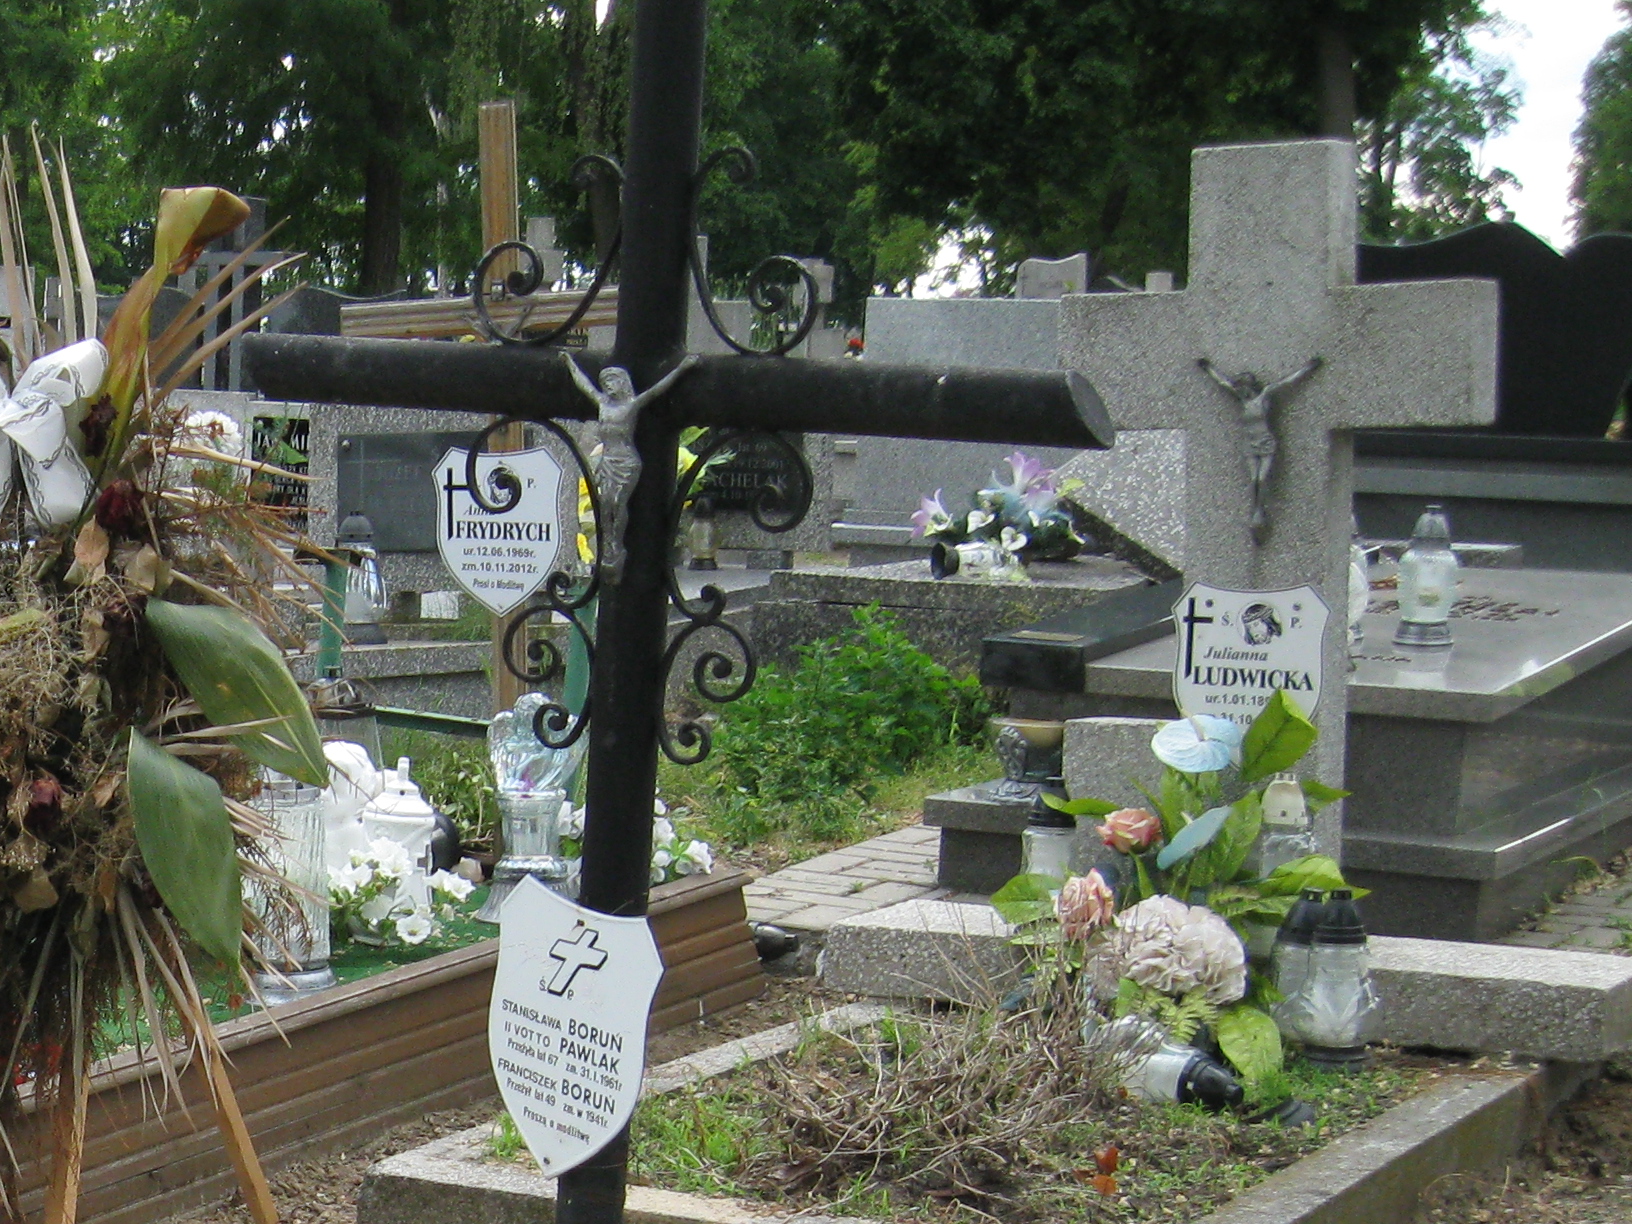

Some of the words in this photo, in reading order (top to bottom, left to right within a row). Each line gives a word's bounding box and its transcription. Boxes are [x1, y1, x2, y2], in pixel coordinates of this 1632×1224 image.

[527, 478, 538, 489] P.
[455, 519, 551, 541] FRYDRYCH
[1203, 646, 1268, 661] Julianna
[1192, 665, 1314, 691] LUDWICKA
[502, 998, 562, 1032] STANISŁAWA
[568, 1018, 624, 1053] BORUŃ
[547, 1053, 559, 1067] 67
[559, 1037, 621, 1075] PAWLAK
[497, 1057, 558, 1091] FRANCISZEK
[561, 1078, 616, 1115] BORUŃ
[544, 1095, 556, 1108] 49
